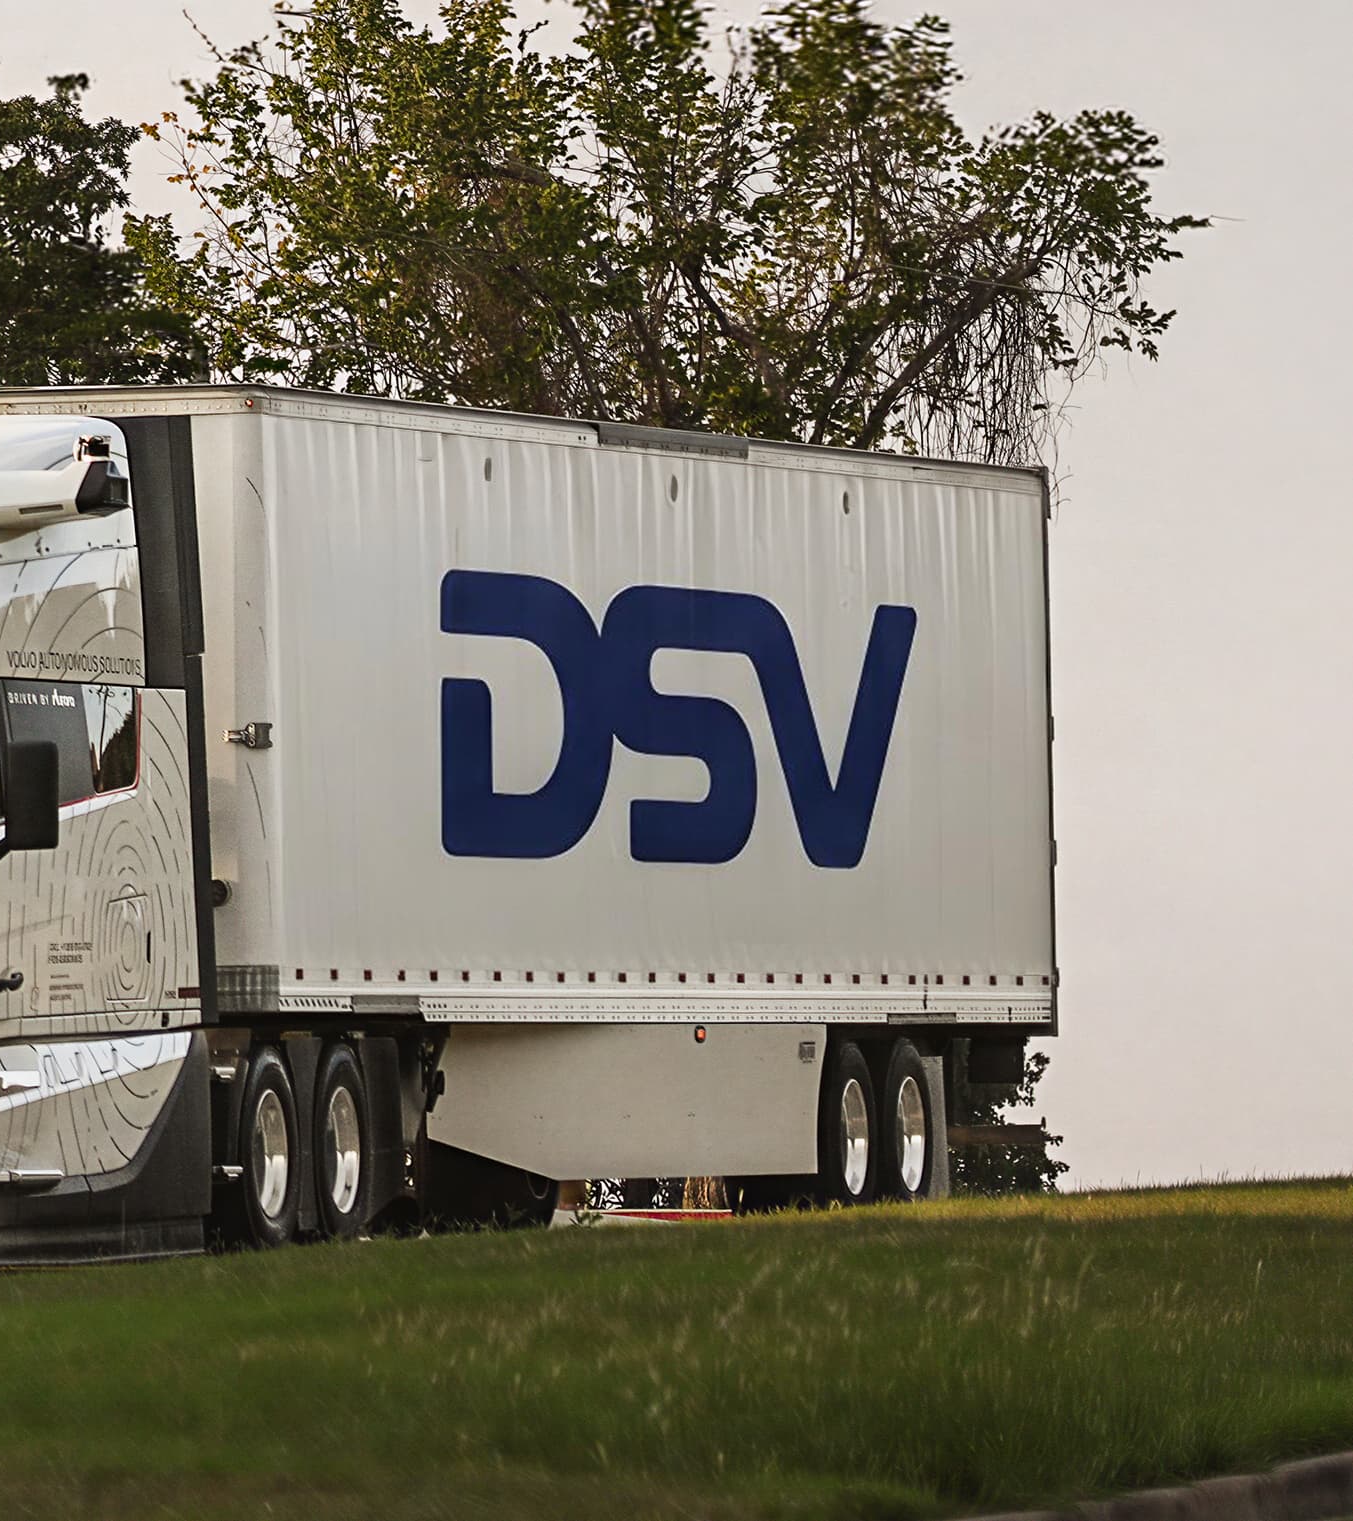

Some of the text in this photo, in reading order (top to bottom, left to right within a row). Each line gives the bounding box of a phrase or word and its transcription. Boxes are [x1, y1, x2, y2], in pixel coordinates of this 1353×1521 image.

[6, 651, 142, 675] VOLVO AUTONOMOUS SOLUTIONS
[7, 691, 37, 705] DRIVEN
[440, 569, 917, 869] DSV
